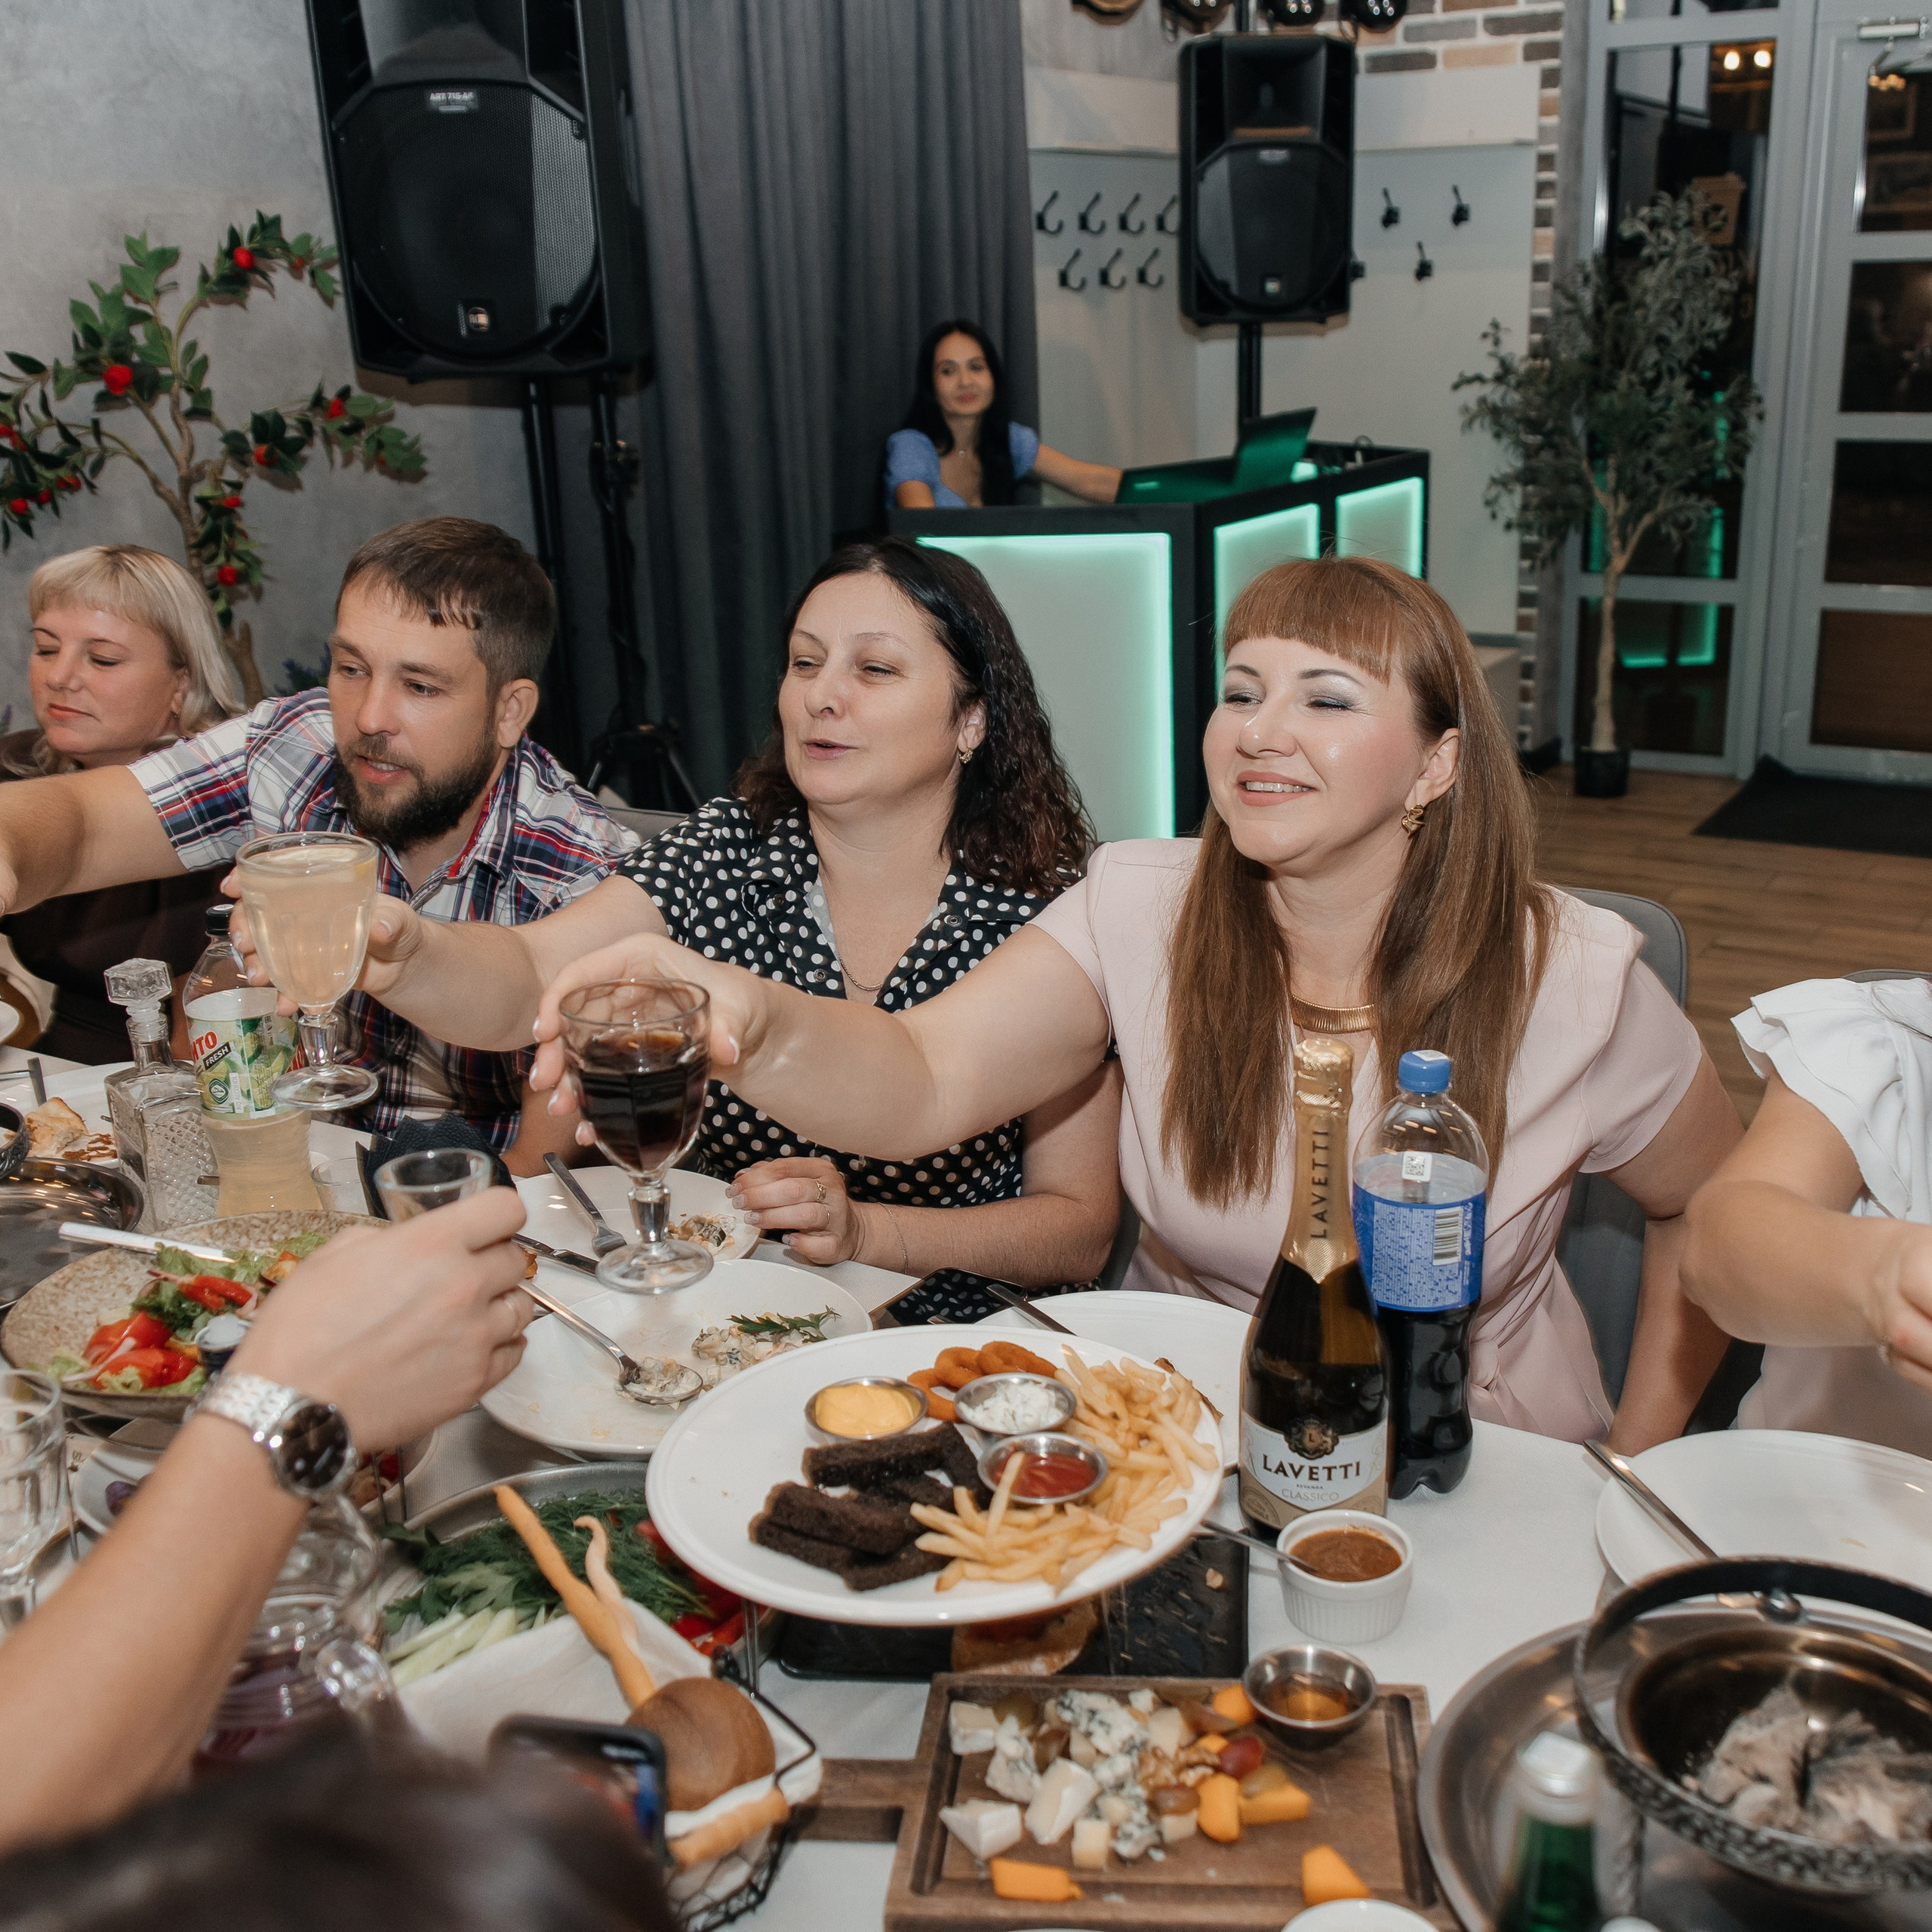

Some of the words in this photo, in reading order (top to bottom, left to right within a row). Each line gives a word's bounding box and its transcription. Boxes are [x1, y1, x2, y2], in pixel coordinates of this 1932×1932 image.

[205, 1046, 229, 1067] FRESH
[1310, 1131, 1328, 1239] LAVETTI
[1263, 1454, 1361, 1481] LAVETTI
[1281, 1488, 1340, 1502] CLASSICO
